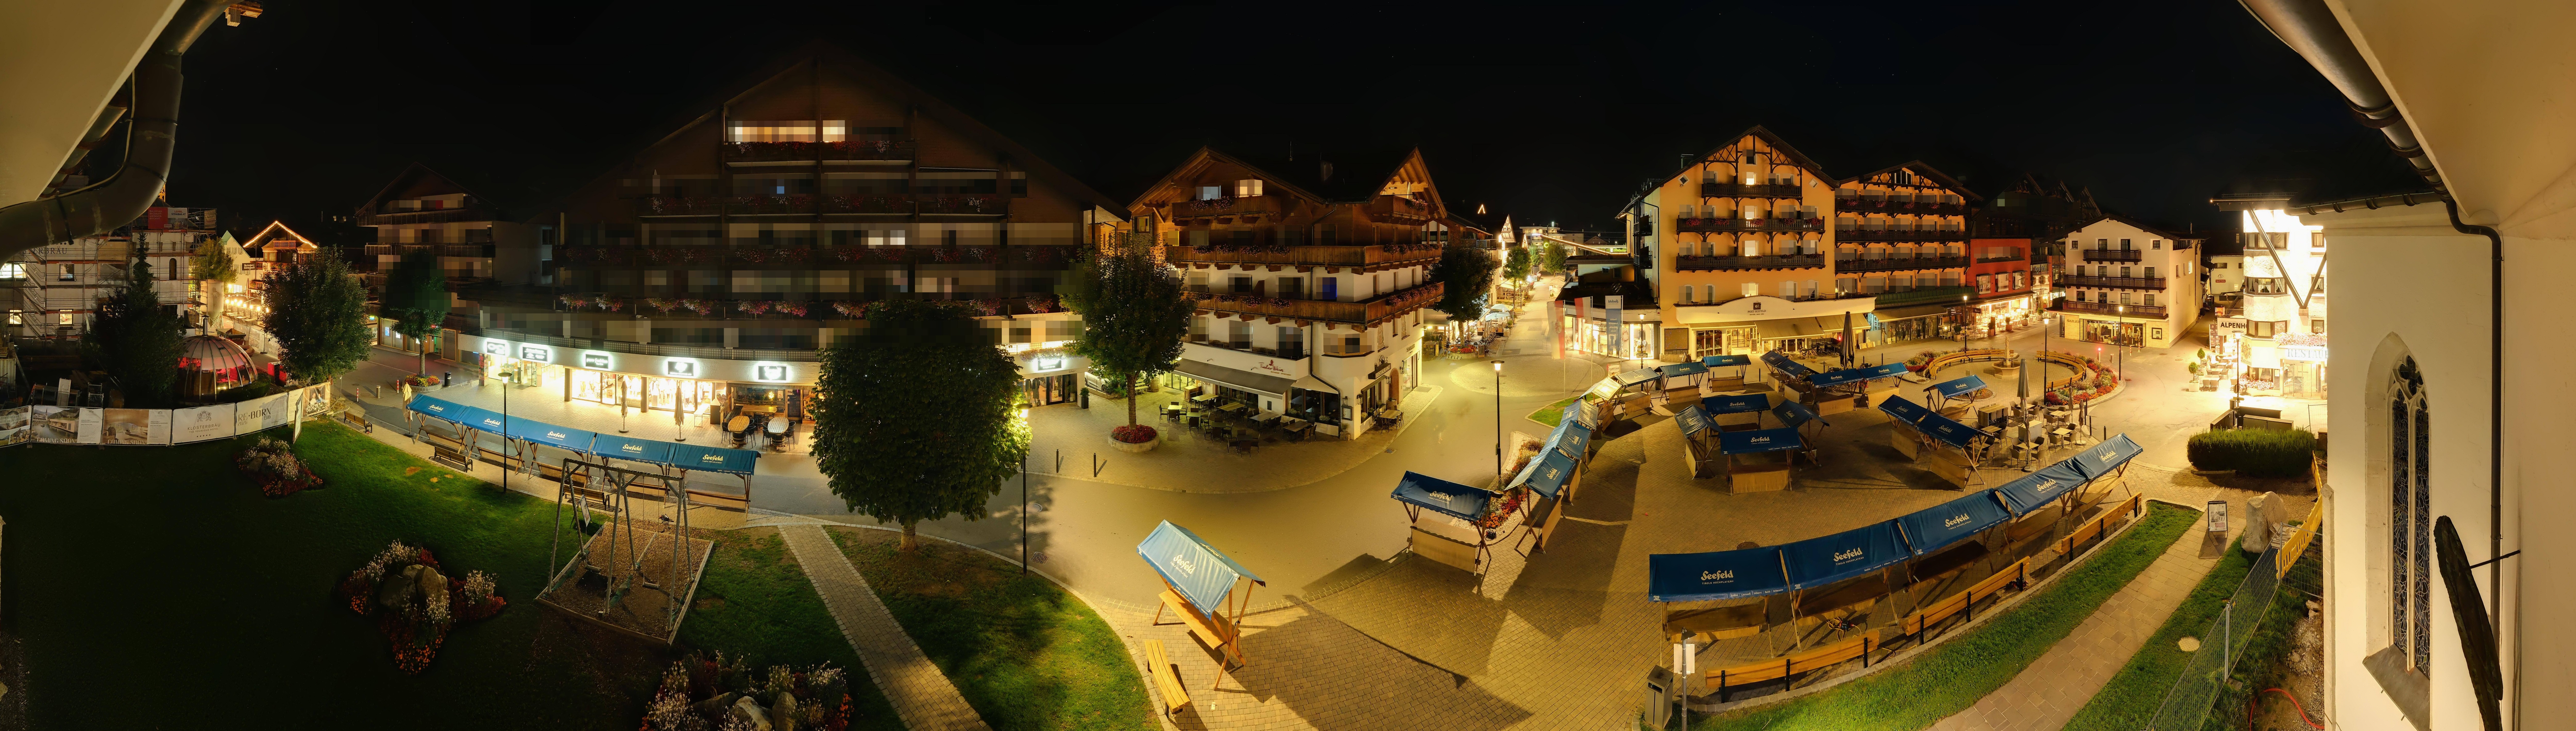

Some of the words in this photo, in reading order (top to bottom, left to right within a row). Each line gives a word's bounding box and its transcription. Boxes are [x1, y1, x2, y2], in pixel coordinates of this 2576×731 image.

[1376, 365, 1390, 378] RESTAURANT
[1939, 425, 1953, 433] Seefeld
[2100, 450, 2116, 461] Seefeld
[1547, 468, 1557, 479] Seefeld
[2037, 479, 2056, 491] Seefeld
[1430, 491, 1452, 501] Seefeld
[1945, 513, 1969, 527] Seefeld
[1834, 547, 1863, 562] Seefeld
[1173, 554, 1196, 574] Seefeld
[1175, 566, 1188, 578] HOCHPLATEAU
[1701, 570, 1734, 581] Seefeld
